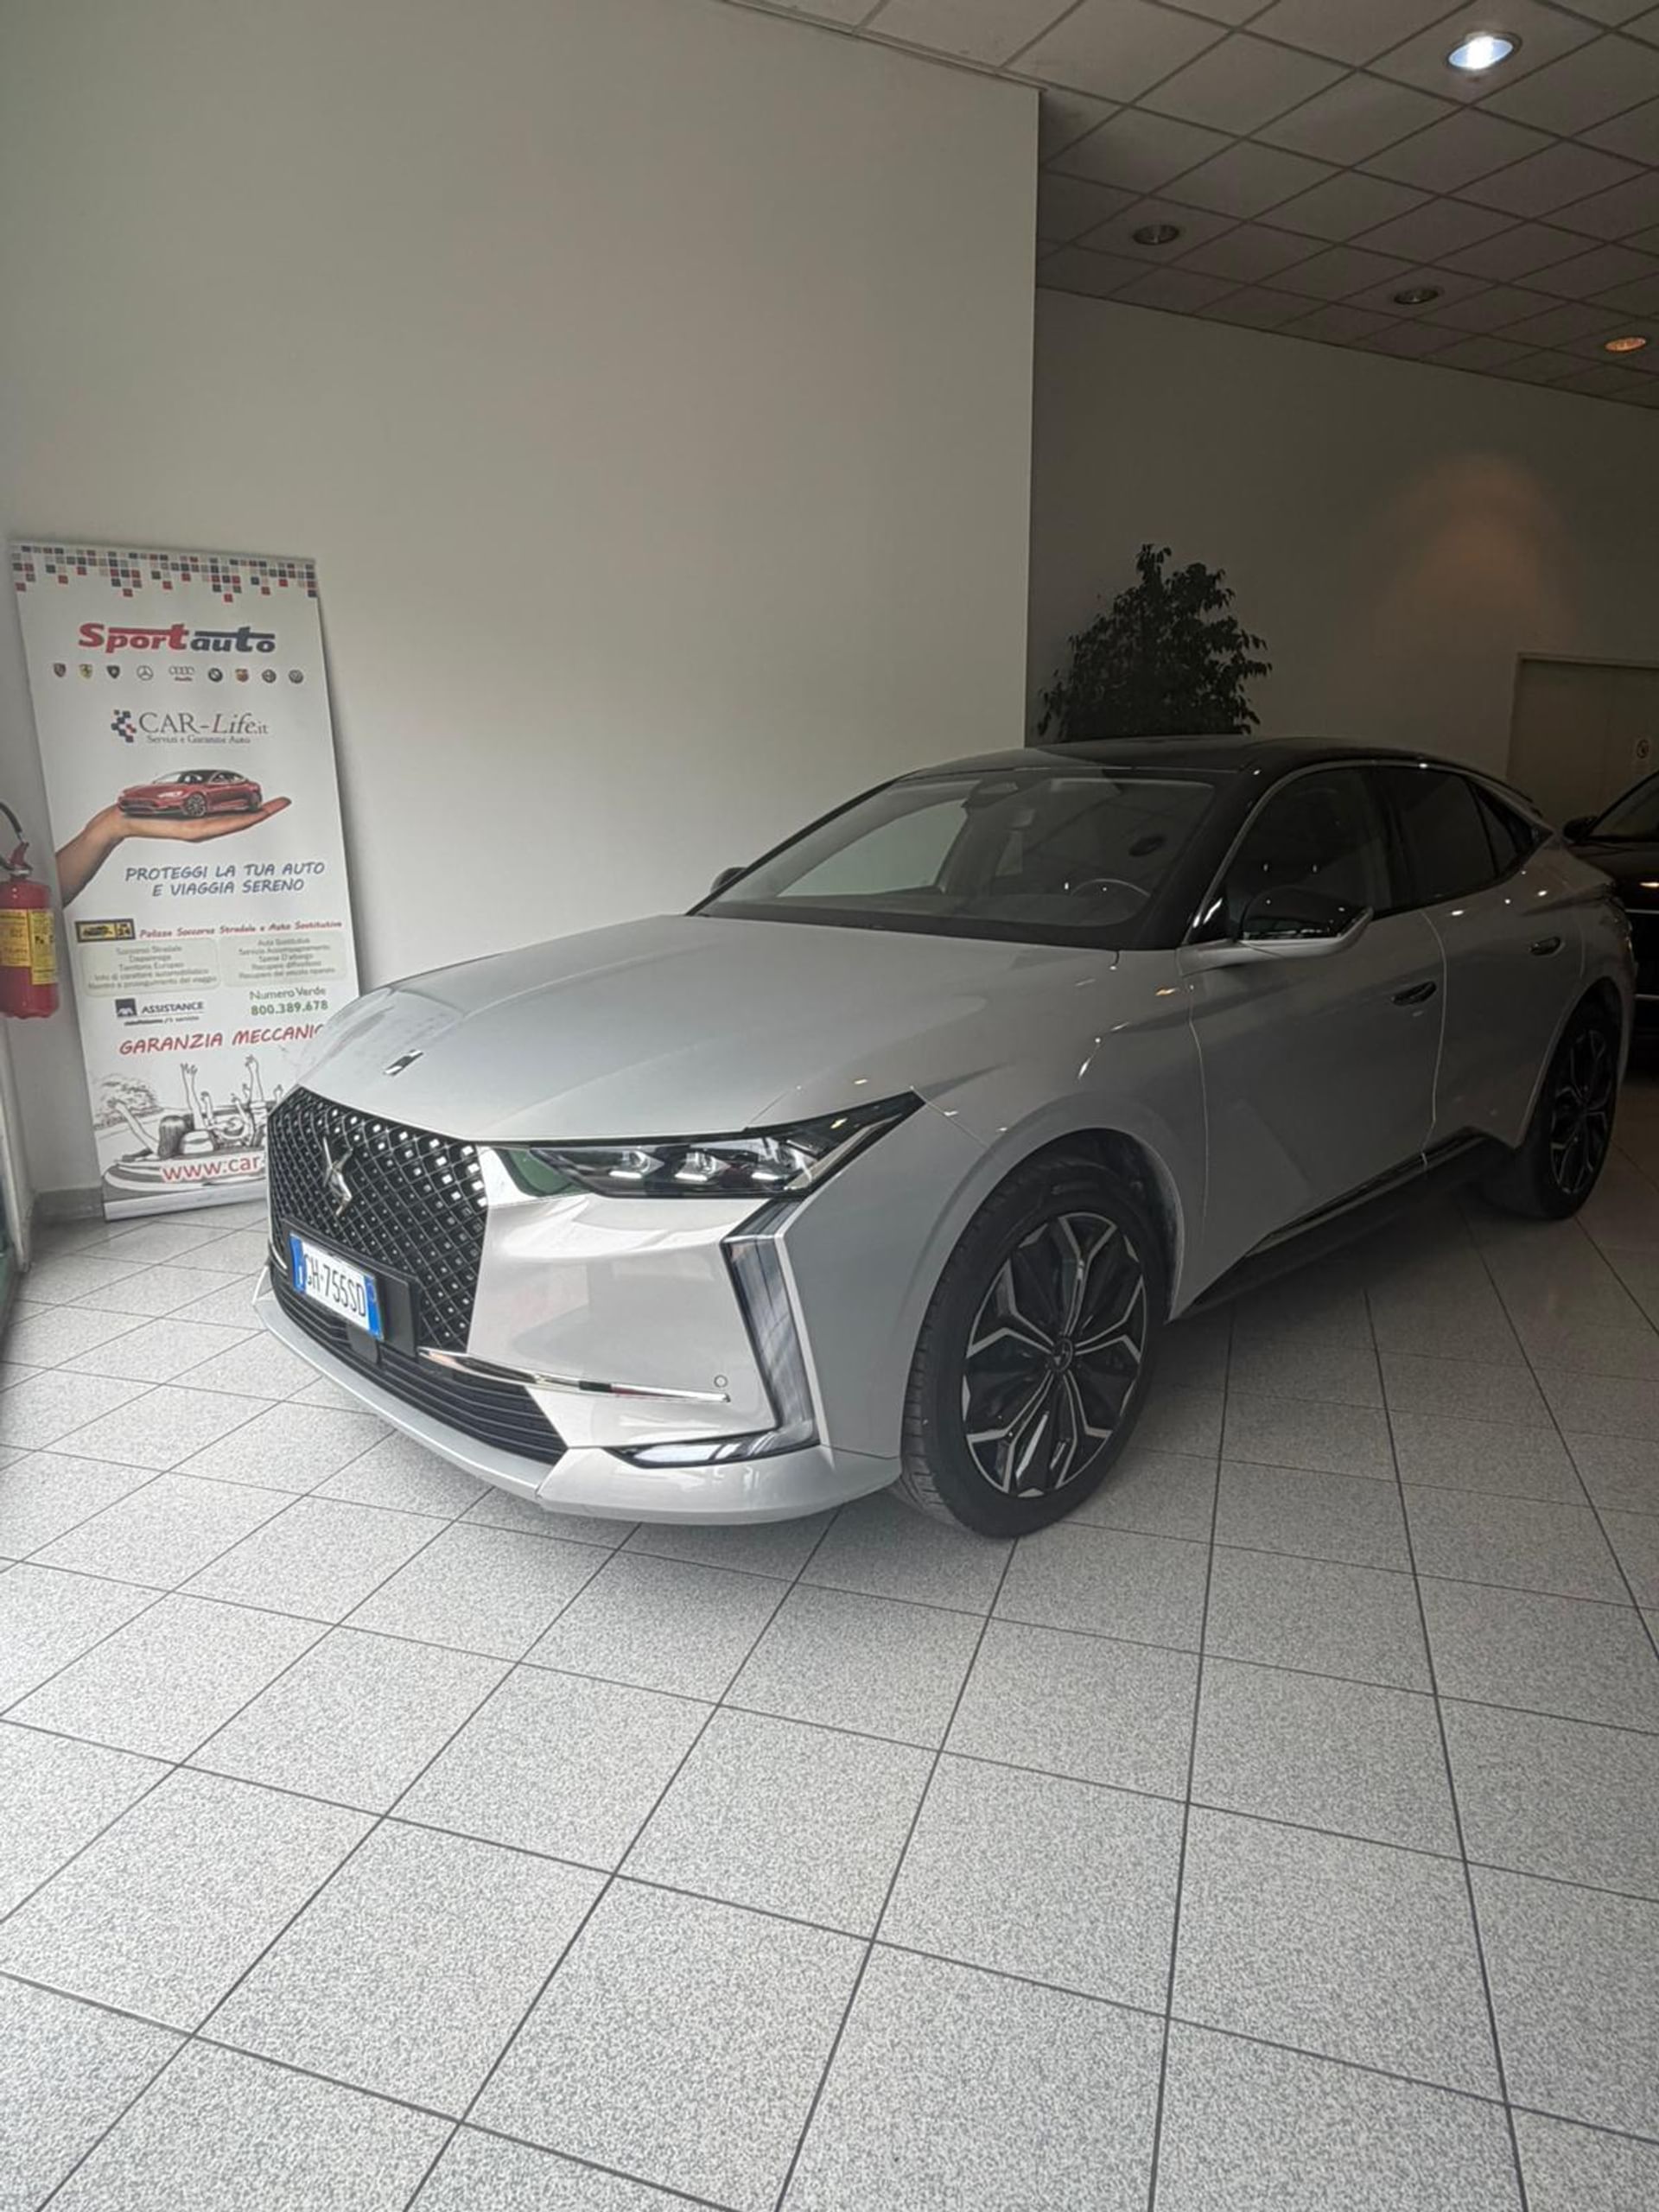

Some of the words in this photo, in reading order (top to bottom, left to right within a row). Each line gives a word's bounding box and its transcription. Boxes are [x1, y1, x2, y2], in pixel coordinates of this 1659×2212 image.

[125, 865, 207, 880] PROTEGGI
[216, 864, 235, 878] LA
[245, 863, 274, 876] TUA
[282, 861, 325, 875] AUTO
[152, 884, 162, 896] E
[170, 881, 234, 895] VIAGGIA
[242, 879, 304, 893] SERENO
[249, 988, 295, 1000] Numero
[295, 986, 326, 996] Verde
[141, 1001, 204, 1014] ASSISTANCE
[251, 1000, 328, 1016] 800.389.678
[119, 1032, 222, 1055] GARANZIA
[162, 1154, 265, 1181] www.car
